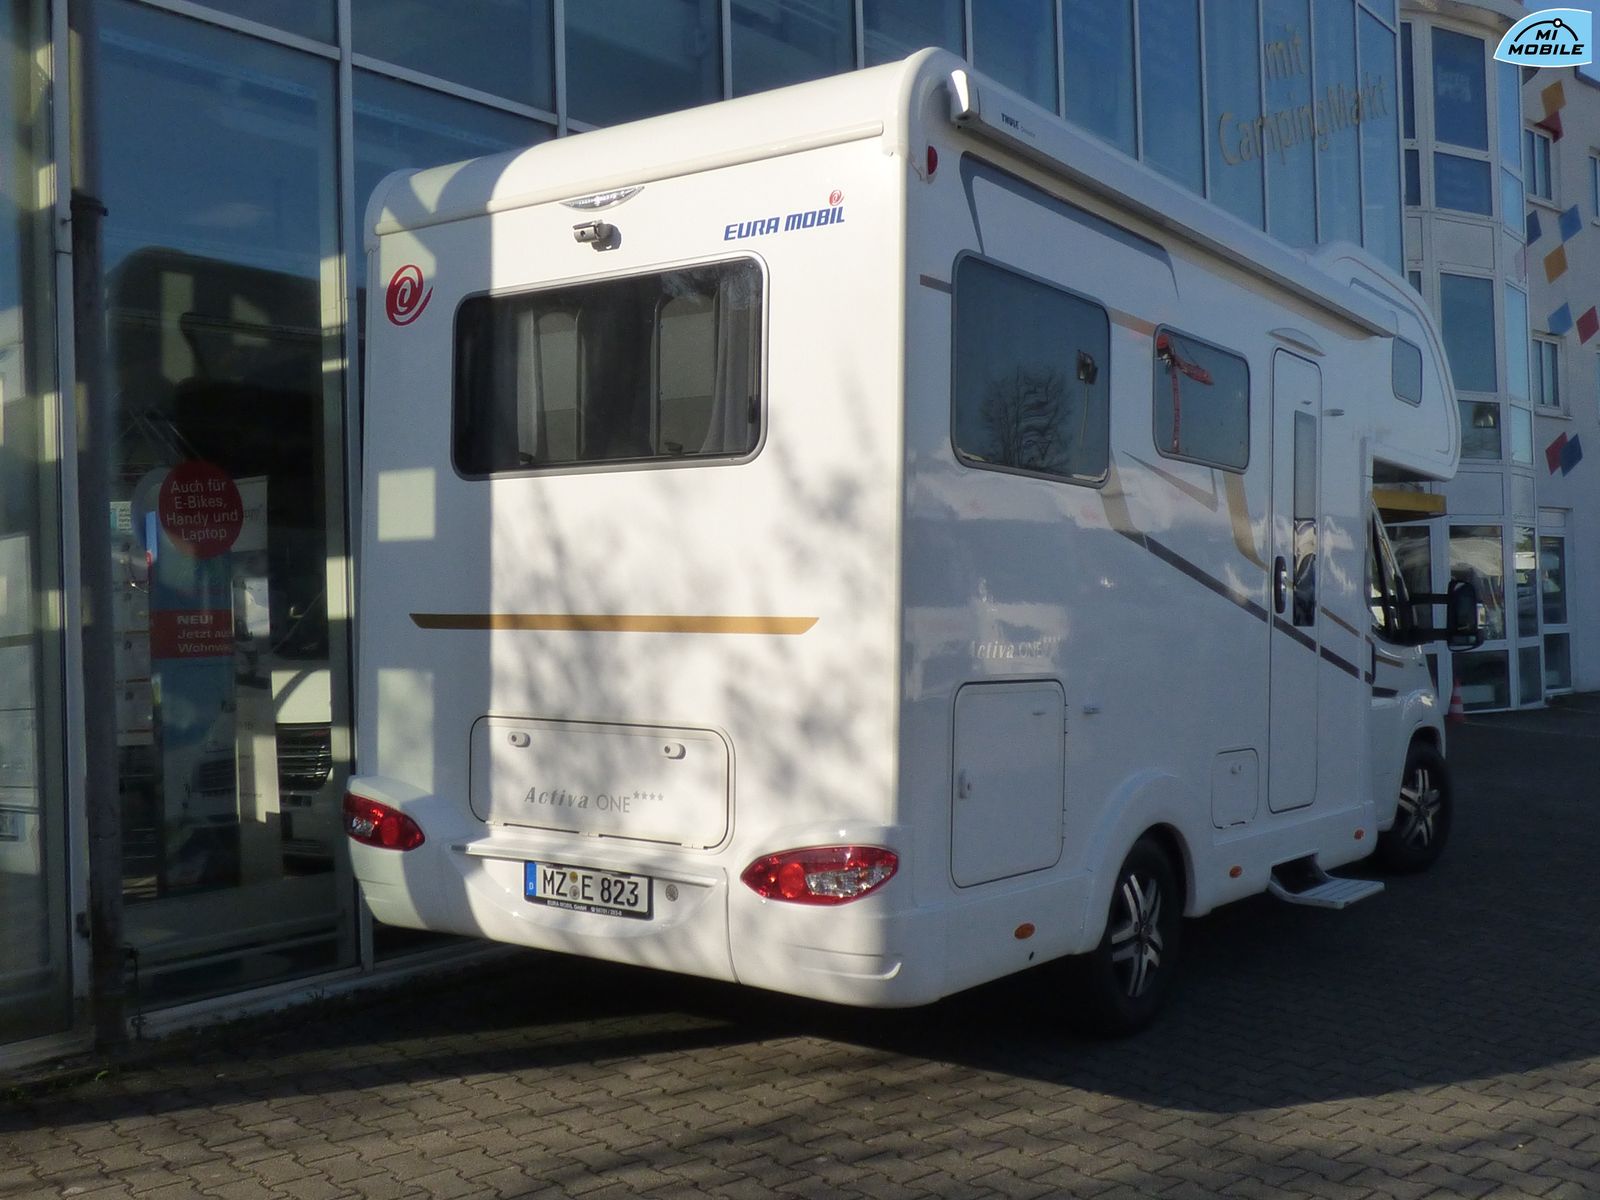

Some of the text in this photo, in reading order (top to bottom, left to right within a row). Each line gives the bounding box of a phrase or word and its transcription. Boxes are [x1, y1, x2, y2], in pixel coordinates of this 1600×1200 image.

[1264, 24, 1308, 81] mit
[724, 206, 845, 241] EURA MOBIL
[170, 478, 228, 494] Auch für
[174, 495, 228, 510] E-Bikes,
[166, 511, 209, 527] Handy
[213, 509, 239, 522] und
[181, 527, 228, 543] Laptop
[177, 630, 211, 640] Jetzt
[524, 786, 631, 813] Activa ONE
[543, 869, 639, 907] MZ E 823
